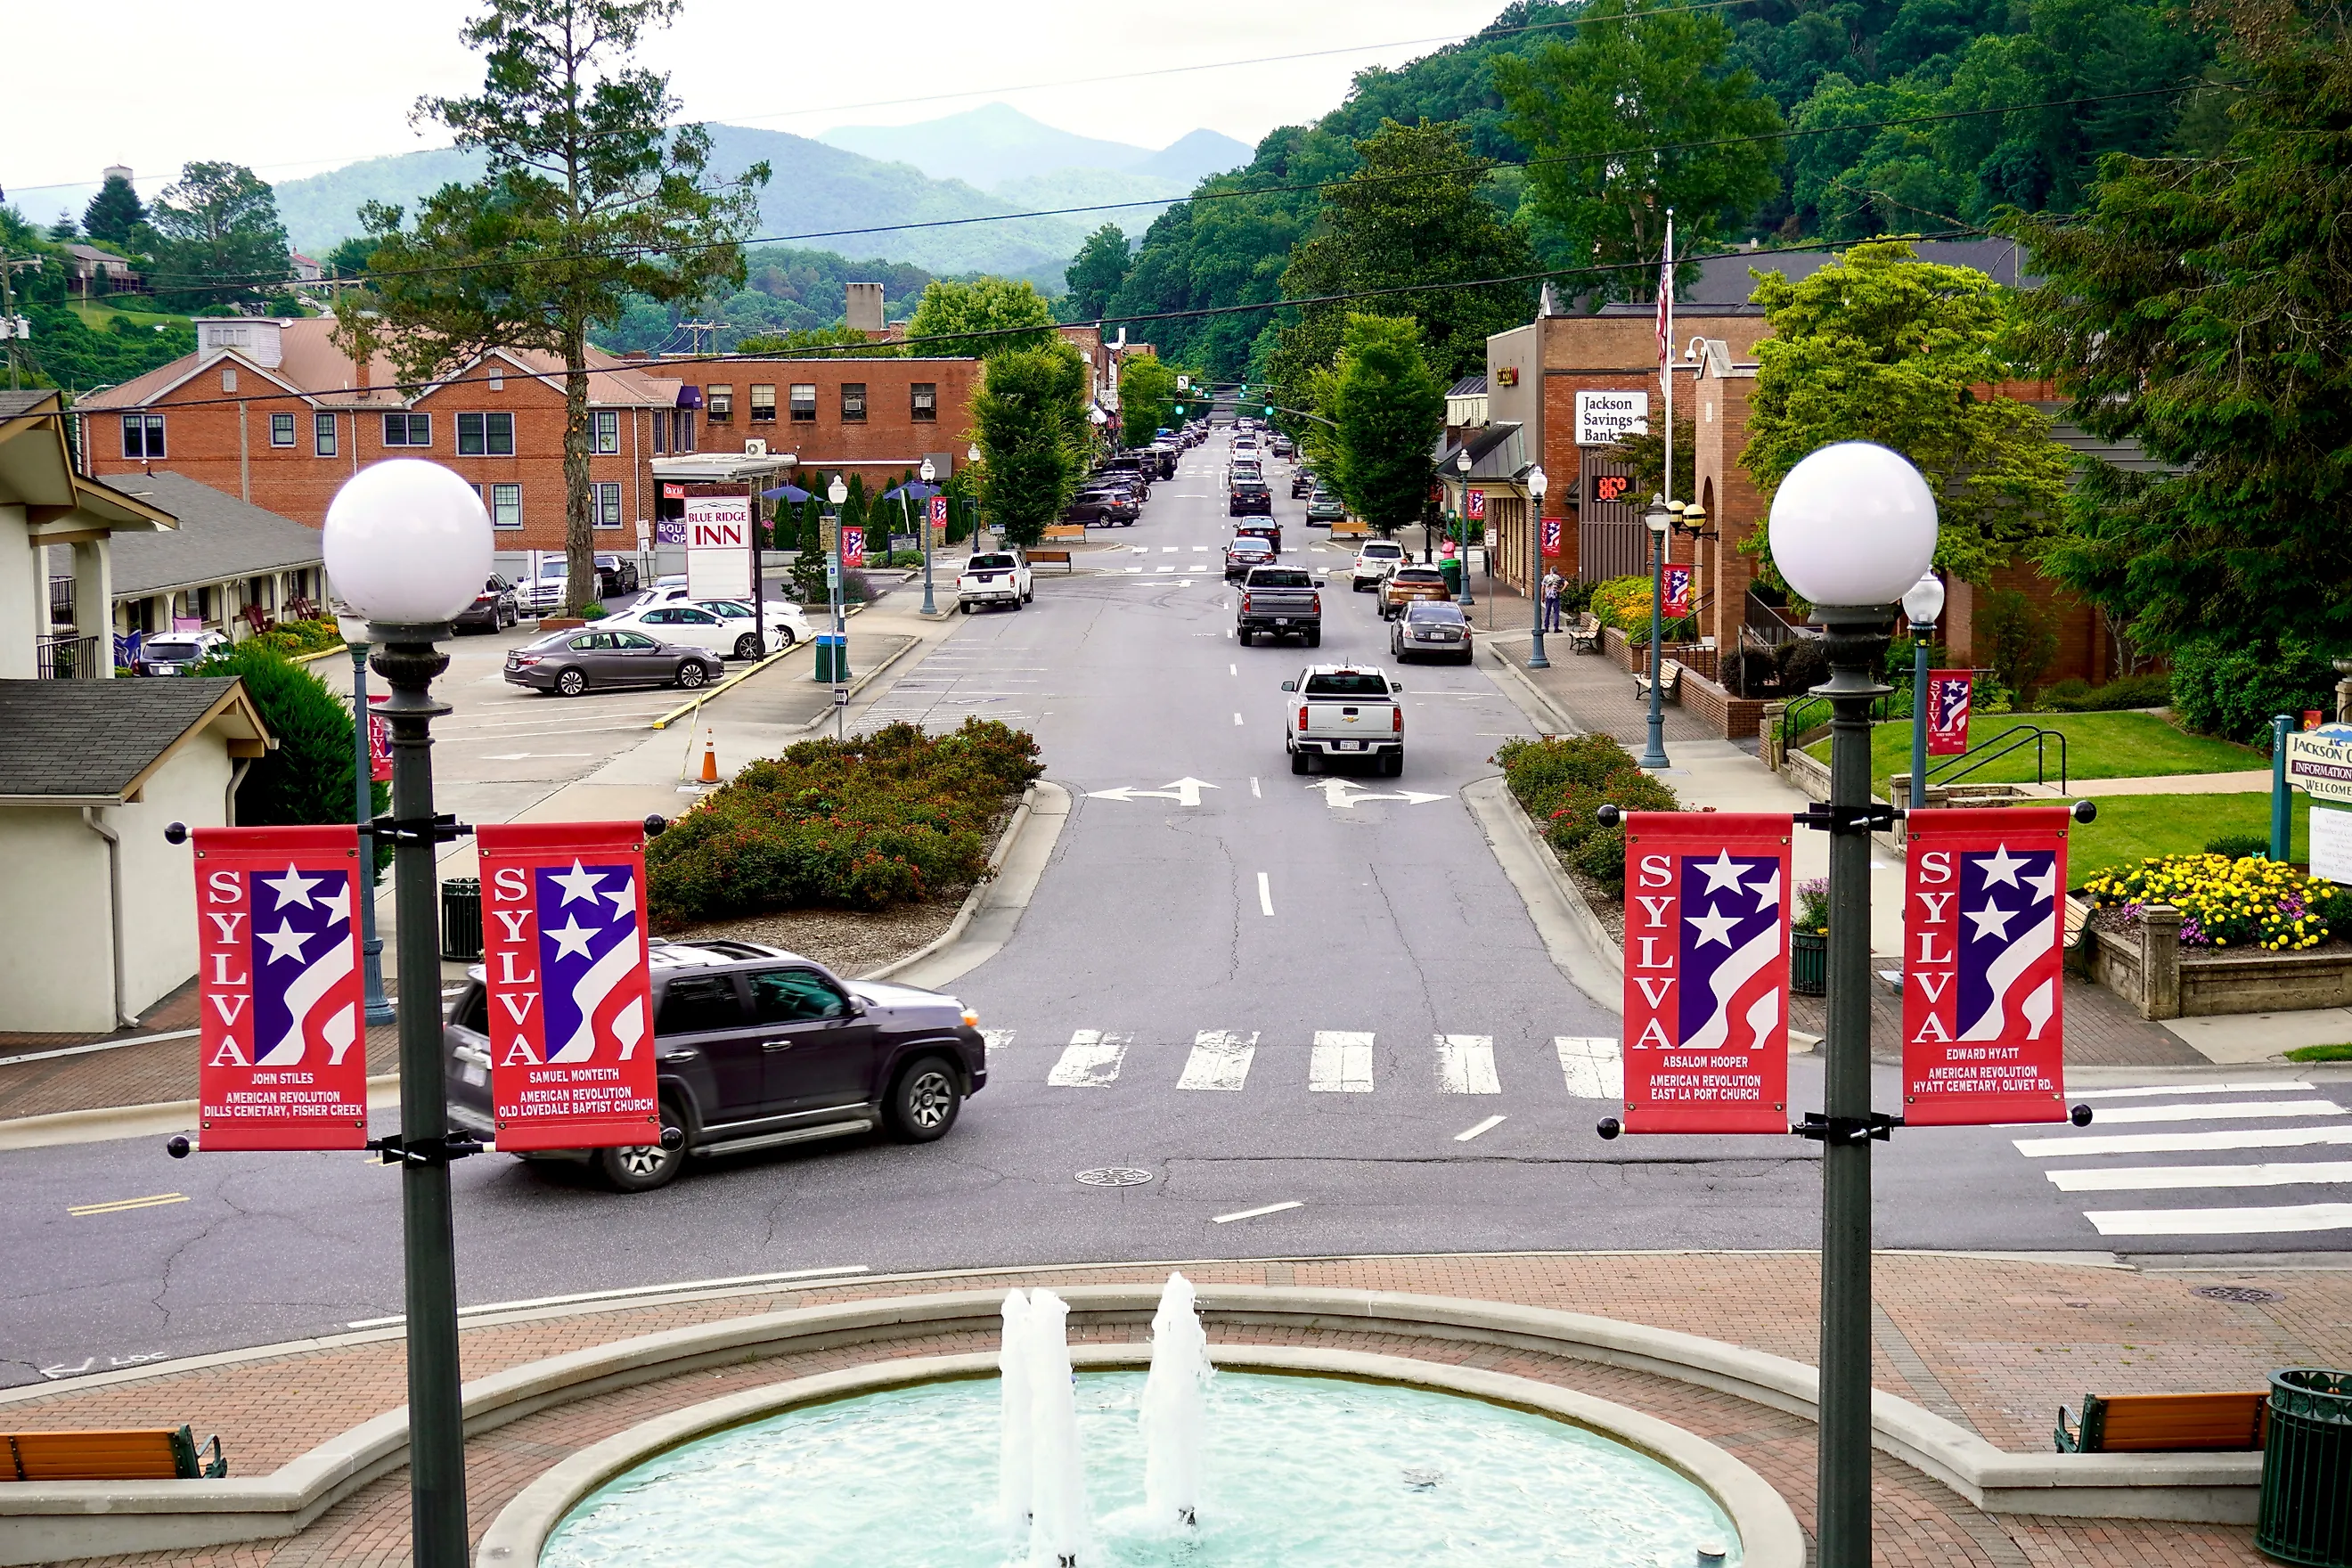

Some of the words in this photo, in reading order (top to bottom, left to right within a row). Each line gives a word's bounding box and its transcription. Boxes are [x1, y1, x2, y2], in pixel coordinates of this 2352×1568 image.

[1584, 396, 1632, 412] Jackson
[1584, 413, 1632, 429] Savings
[1584, 429, 1617, 442] Bank
[689, 512, 712, 522] BLUE
[715, 512, 746, 522] RIDGE
[672, 534, 686, 543] OP
[695, 525, 741, 545] INN
[1663, 570, 1671, 604] SYLVA
[1929, 680, 1940, 732] SYLVA
[372, 716, 385, 759] YLVA
[2293, 737, 2343, 760] JACKSON
[2296, 762, 2352, 780] INFORMATION
[2305, 779, 2352, 796] WELCOME
[1633, 855, 1677, 1050] SYLVA
[1911, 852, 1956, 1043] SYLVA
[207, 871, 253, 1067] SYLVA
[492, 868, 544, 1067] SYLVA
[1663, 1056, 1707, 1068] ABSALOM
[1711, 1056, 1748, 1068] HOOPER
[1946, 1048, 1985, 1060] EDWARD
[1989, 1048, 2019, 1060] HYATT
[252, 1074, 277, 1085] JOHN
[280, 1073, 314, 1084] STILES
[529, 1070, 569, 1084] SAMUEL
[572, 1068, 619, 1081] MONTEITH
[1650, 1075, 1699, 1086] AMERICAN
[1703, 1075, 1761, 1086] REVOLUTION
[1928, 1067, 1977, 1079] AMERICAN
[1980, 1066, 2037, 1078] REVOLUTION
[1651, 1089, 1676, 1100] EAST
[1678, 1089, 1691, 1100] LA
[1694, 1089, 1718, 1100] PORT
[1721, 1089, 1760, 1100] CHURCH
[1913, 1081, 1944, 1093] HYATT
[1947, 1080, 2000, 1094] CEMETARY,
[2002, 1080, 2035, 1091] OLIVET
[2038, 1079, 2053, 1090] RD.
[226, 1092, 277, 1104] AMERICAN
[280, 1091, 341, 1103] REVOLUTION
[520, 1090, 570, 1103] AMERICAN
[573, 1087, 631, 1100] REVOLUTION
[204, 1106, 231, 1117] DILLS
[234, 1106, 290, 1119] CEMETARY,
[292, 1105, 328, 1116] FISHER
[330, 1104, 363, 1116] CREEK
[499, 1105, 518, 1117] OLD
[521, 1103, 570, 1116] LOVEDALE
[573, 1100, 611, 1114] BAPTIST
[614, 1098, 654, 1111] CHURCH
